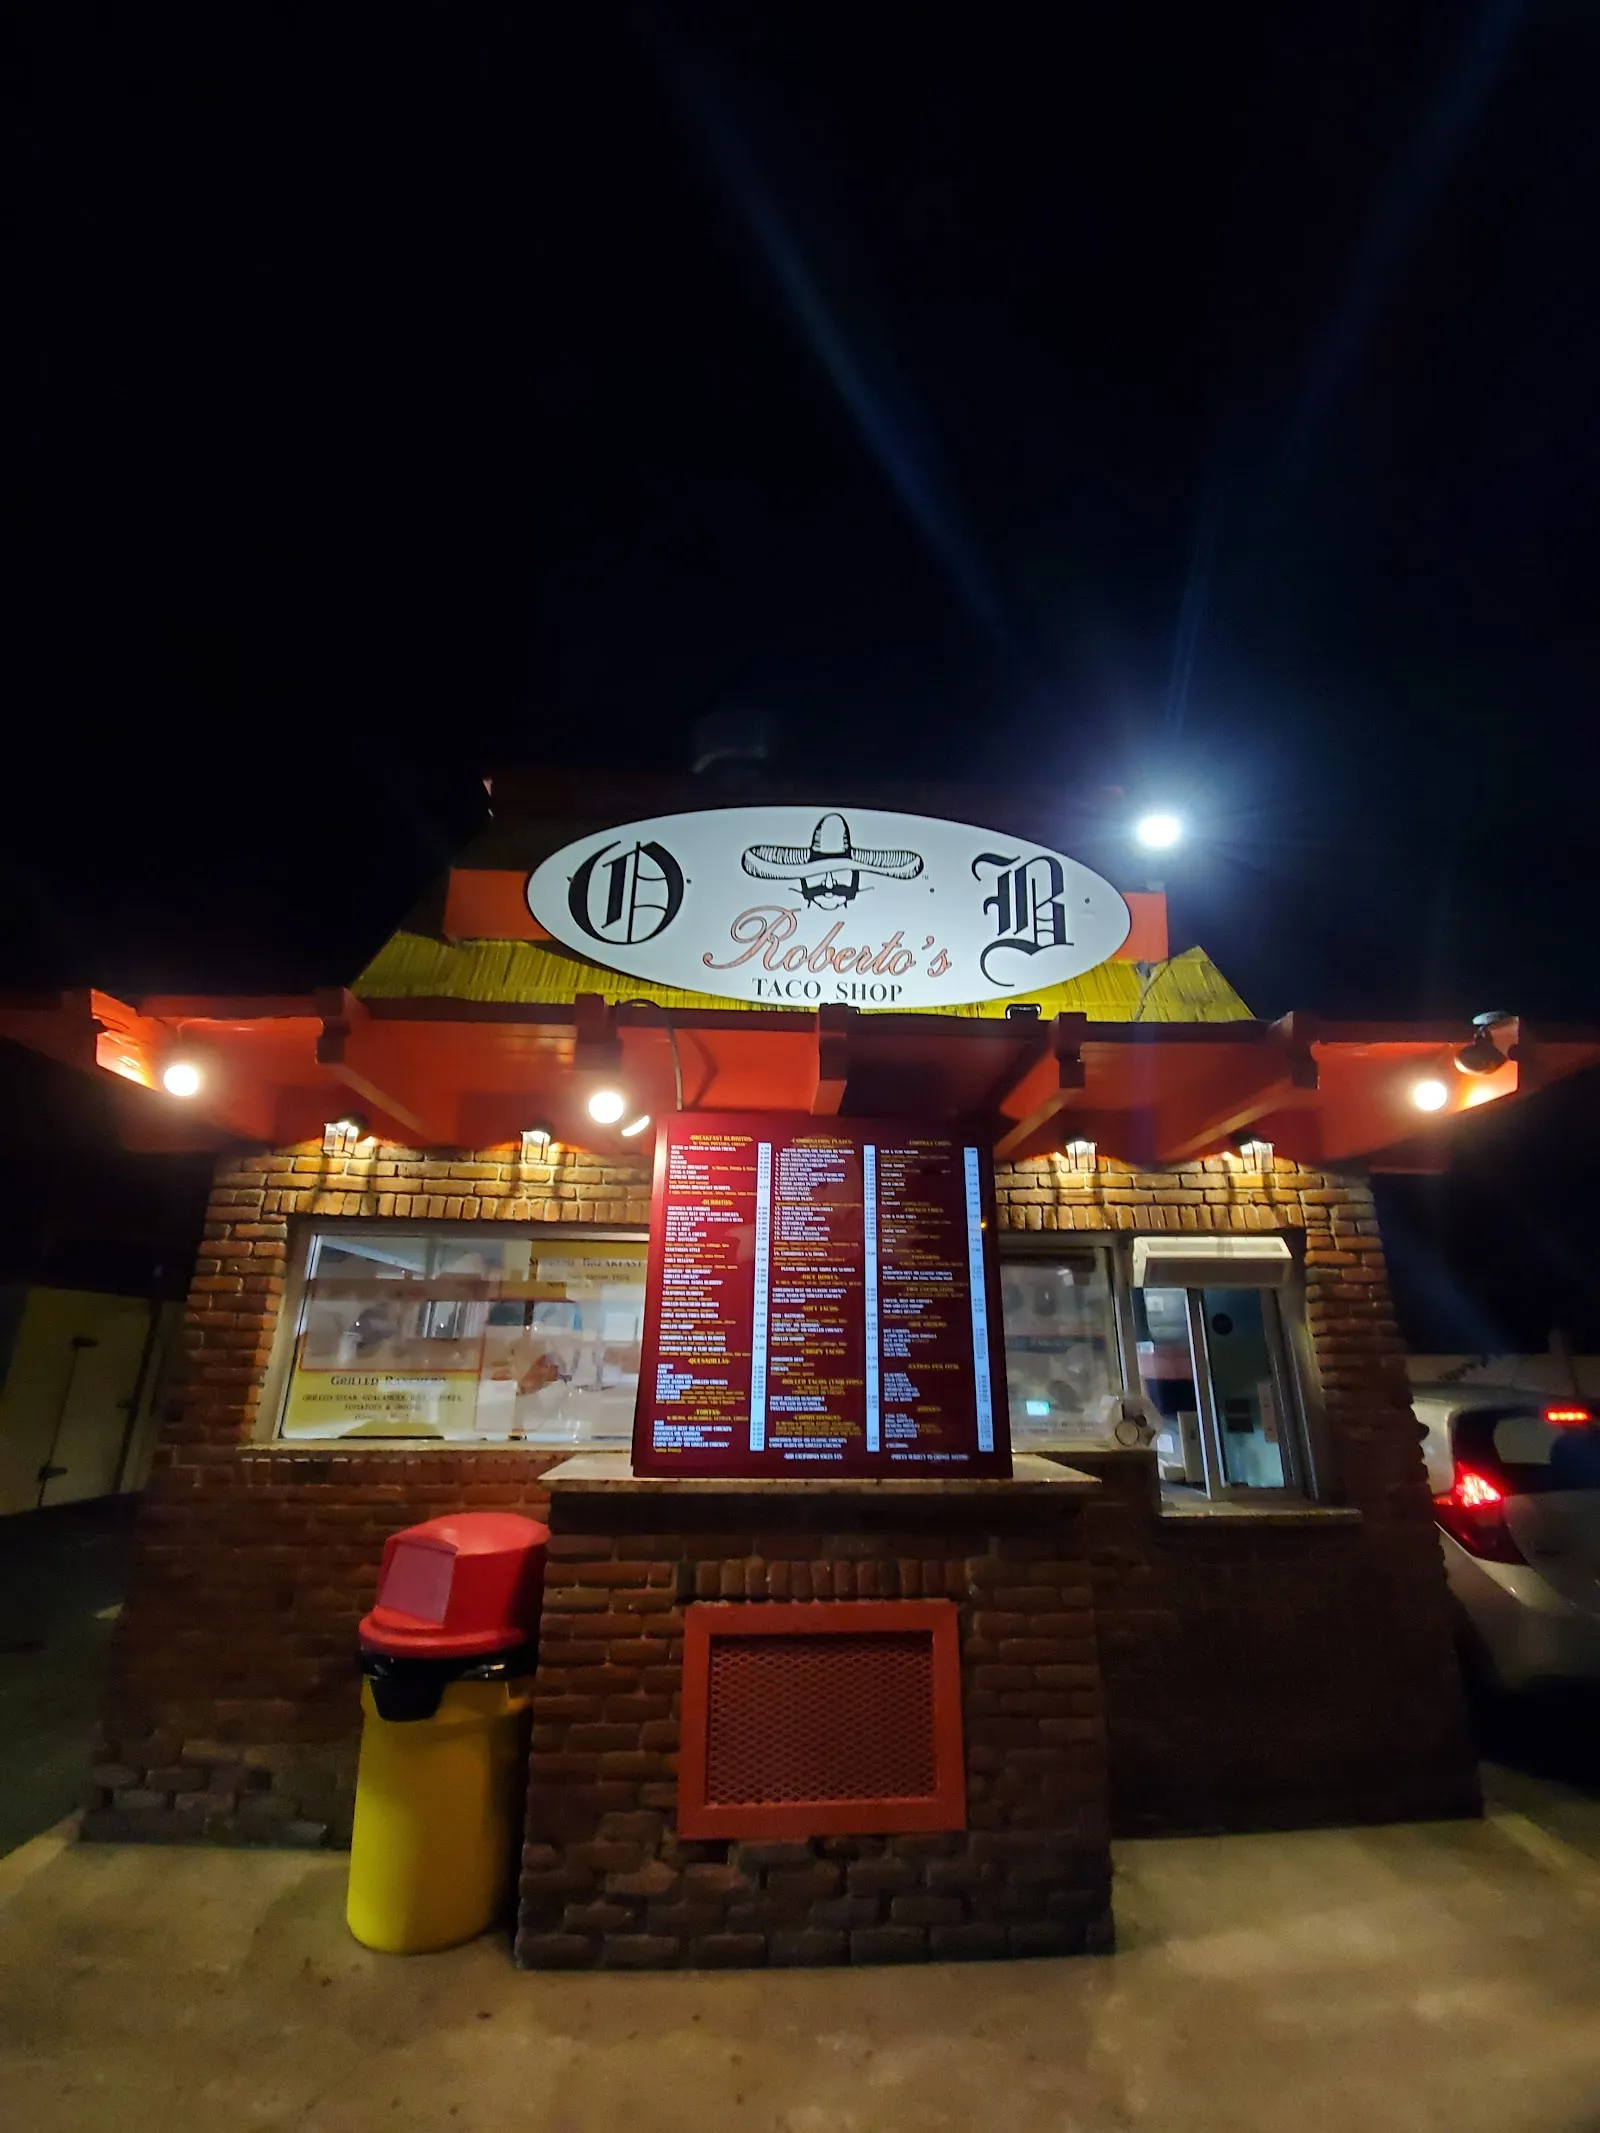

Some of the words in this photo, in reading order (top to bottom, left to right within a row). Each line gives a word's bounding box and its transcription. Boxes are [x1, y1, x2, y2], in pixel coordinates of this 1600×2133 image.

[568, 840, 684, 945] O
[971, 853, 1074, 987] B
[703, 905, 953, 978] Roberto's
[752, 978, 822, 1000] TACO
[836, 981, 903, 1002] SHOP
[331, 1375, 379, 1387] GRILLED
